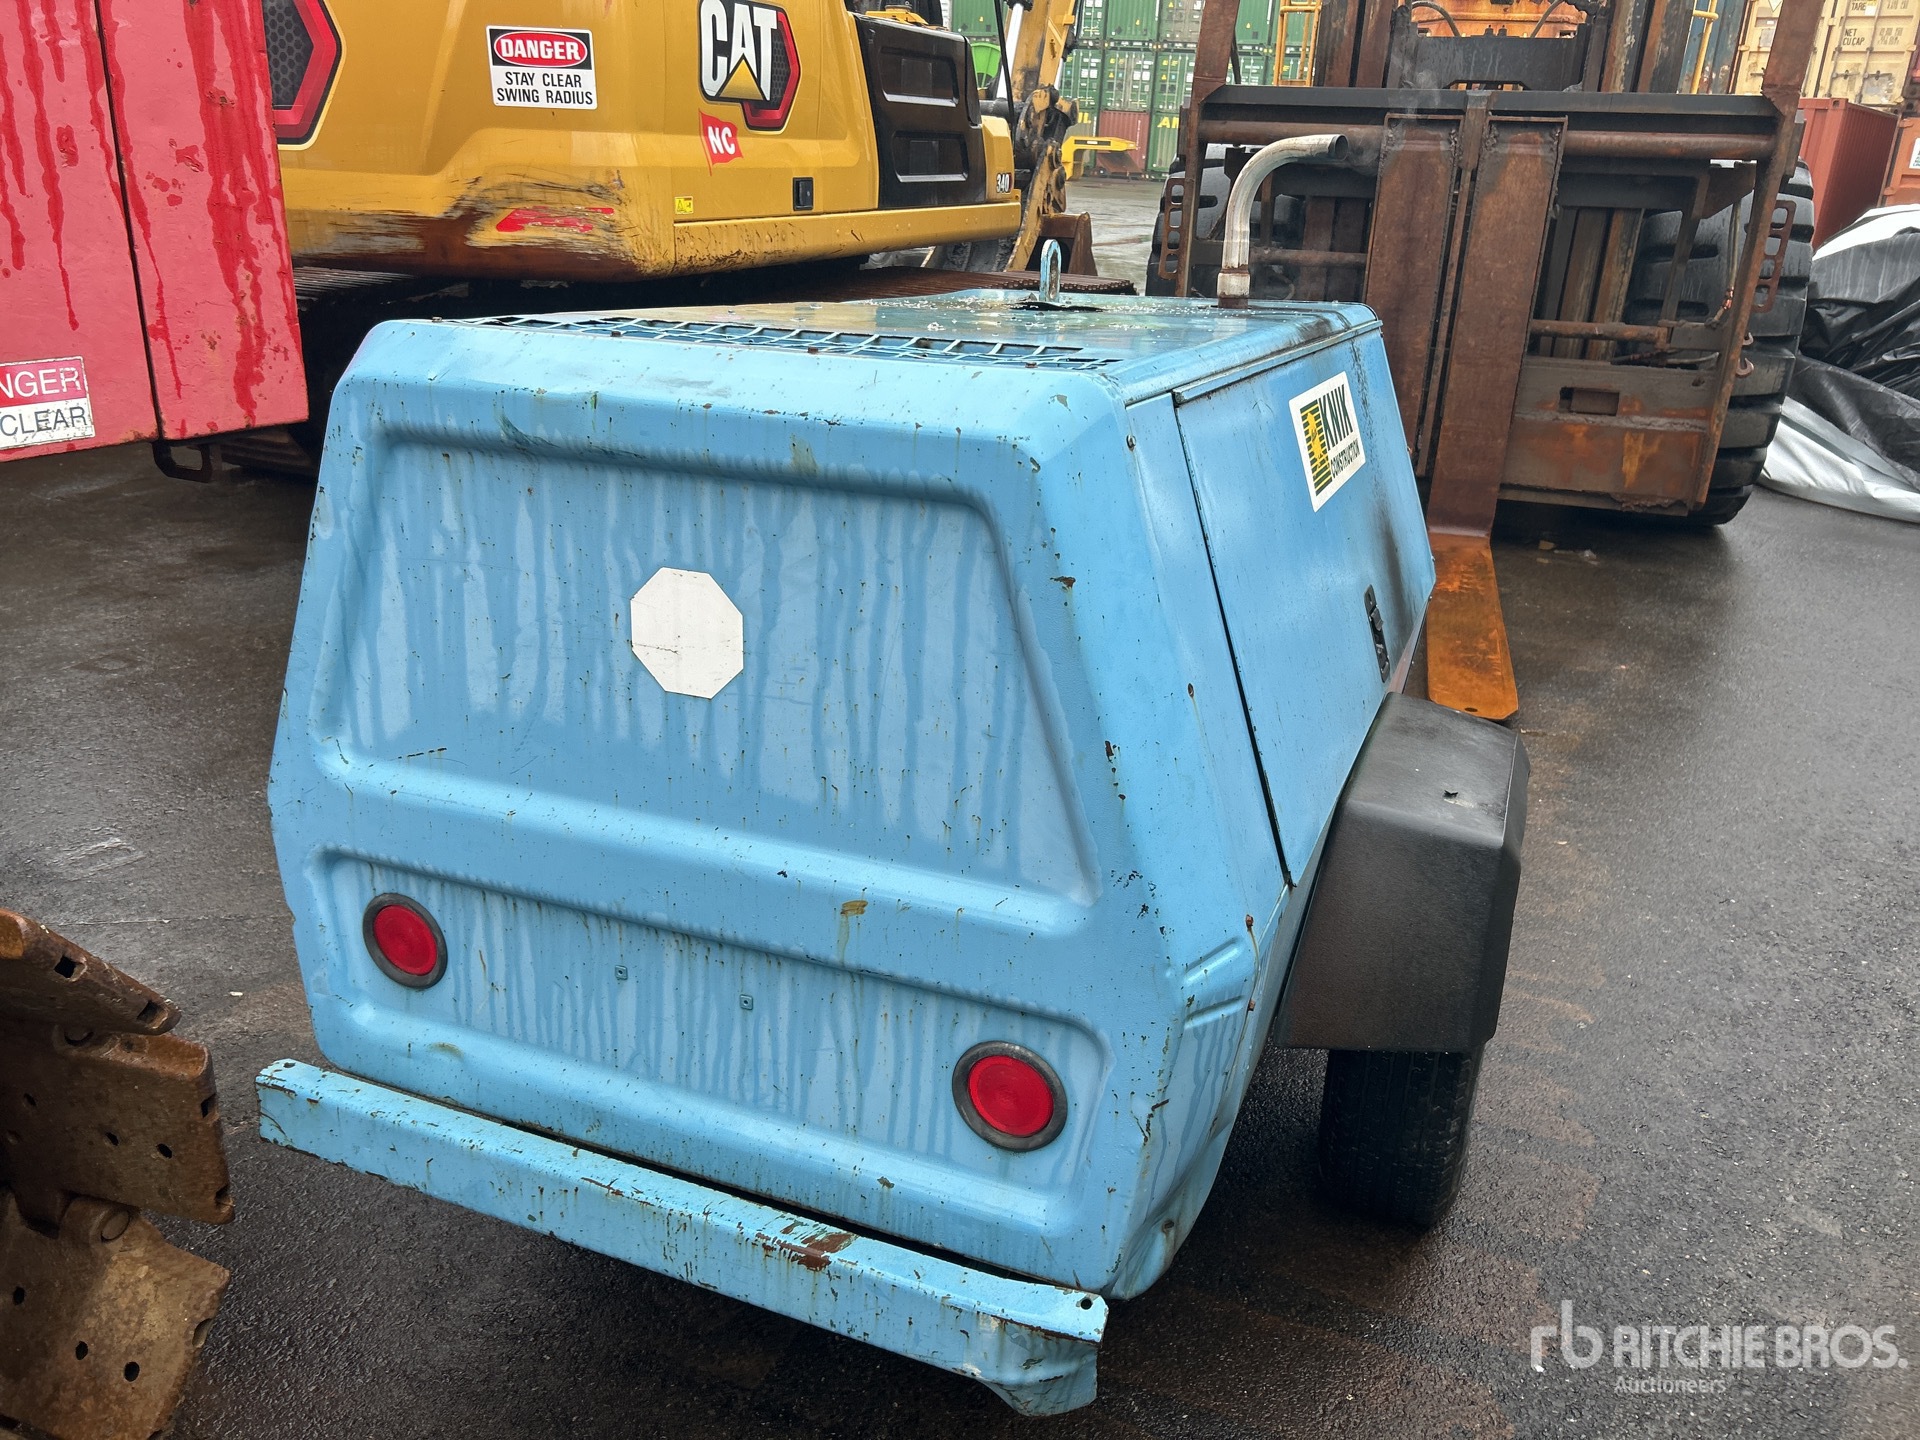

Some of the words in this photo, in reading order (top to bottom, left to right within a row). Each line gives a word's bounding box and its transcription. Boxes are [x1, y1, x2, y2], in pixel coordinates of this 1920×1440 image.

[1845, 28, 1857, 37] NET
[501, 39, 581, 60] DANGER
[700, 0, 777, 101] CAT
[505, 71, 535, 86] STAY
[542, 73, 582, 88] CLEAR
[497, 88, 539, 103] SWING
[546, 90, 593, 105] RADIUS
[708, 126, 736, 155] NC
[997, 173, 1010, 193] 340
[0, 406, 87, 437] CLEAR
[1319, 384, 1353, 451] KNIK
